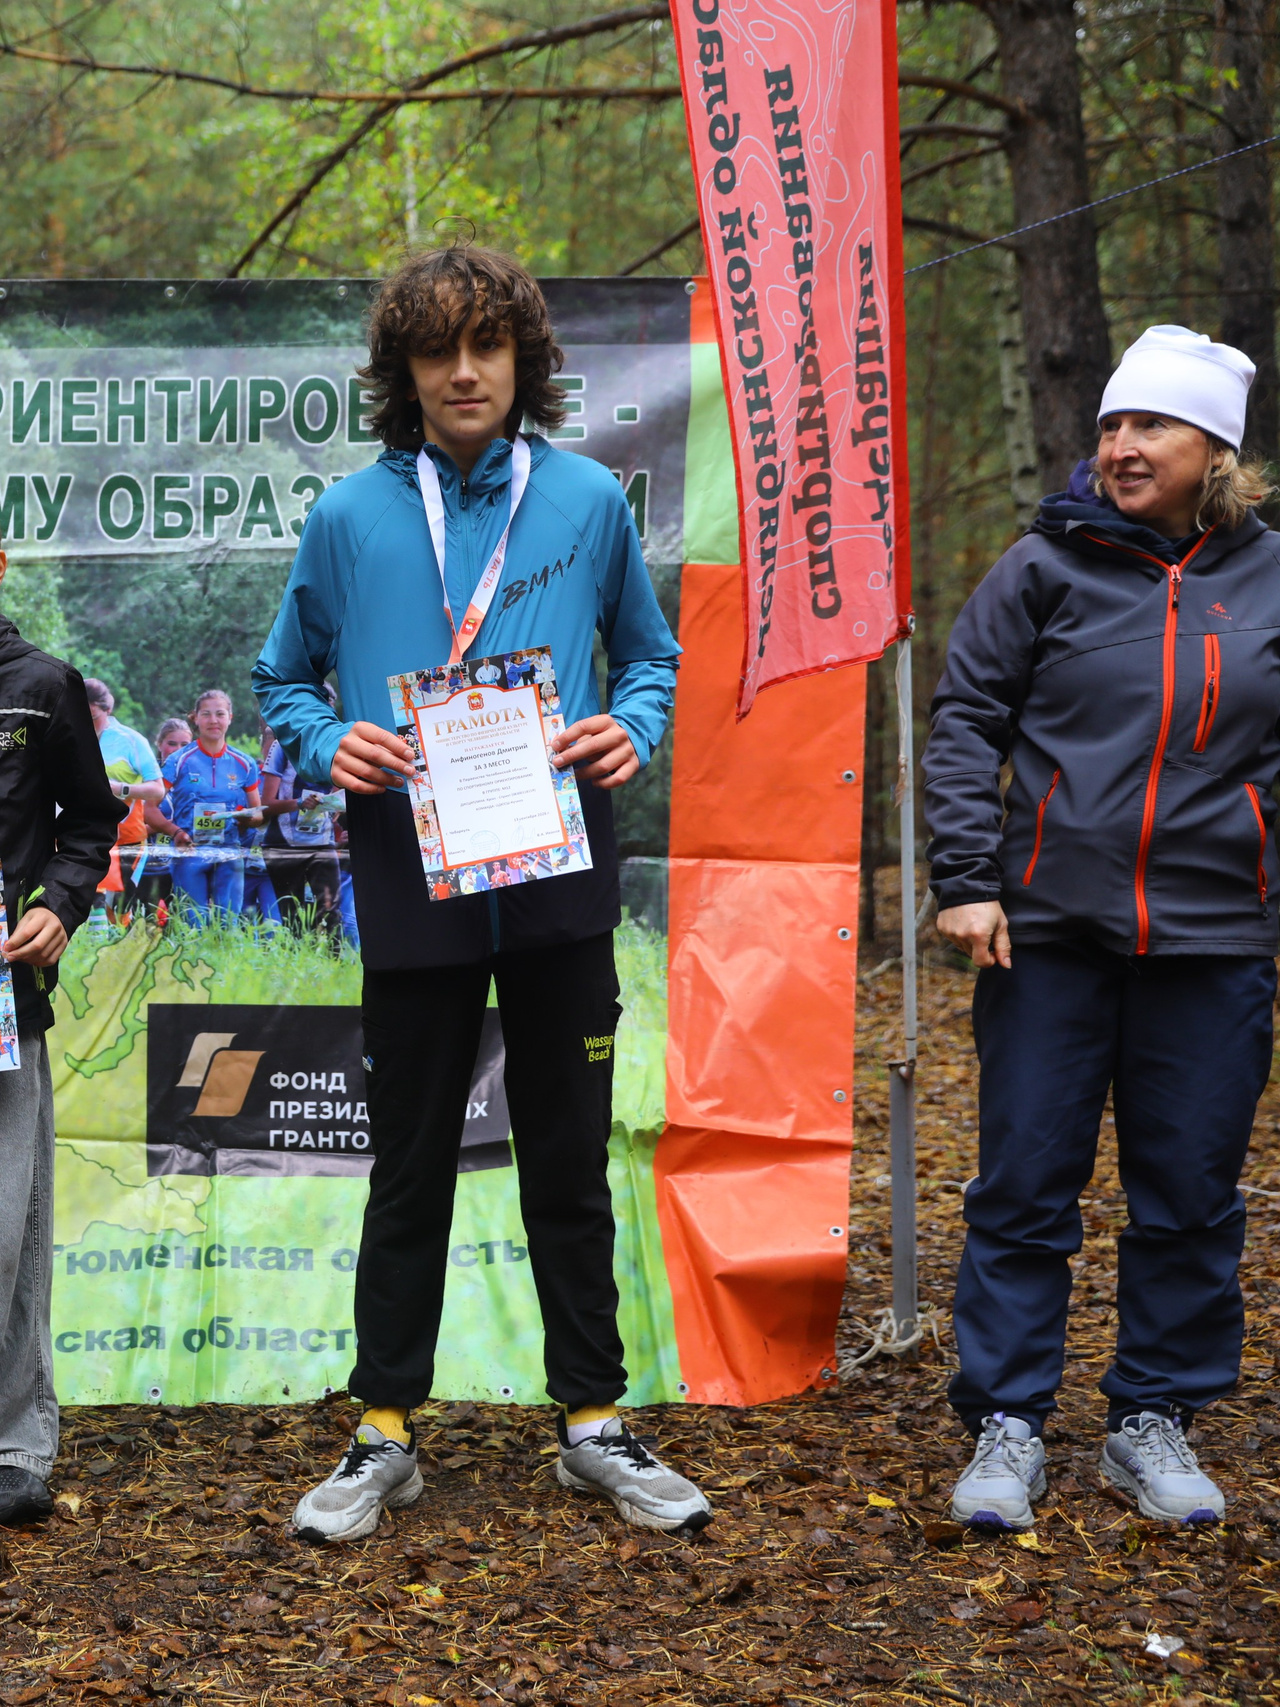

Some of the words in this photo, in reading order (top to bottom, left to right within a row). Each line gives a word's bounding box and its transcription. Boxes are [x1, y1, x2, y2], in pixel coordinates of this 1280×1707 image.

[97, 473, 340, 542] ОБРАЗ
[432, 706, 526, 736] ГРАМОТА
[450, 751, 496, 764] Анфиногенов
[497, 742, 528, 756] Дмитрий
[488, 759, 511, 768] МЕСТО
[270, 1072, 347, 1094] ФОНД
[270, 1130, 370, 1149] ГРАНТО
[53, 1243, 314, 1275] юменская
[183, 1316, 357, 1353] област
